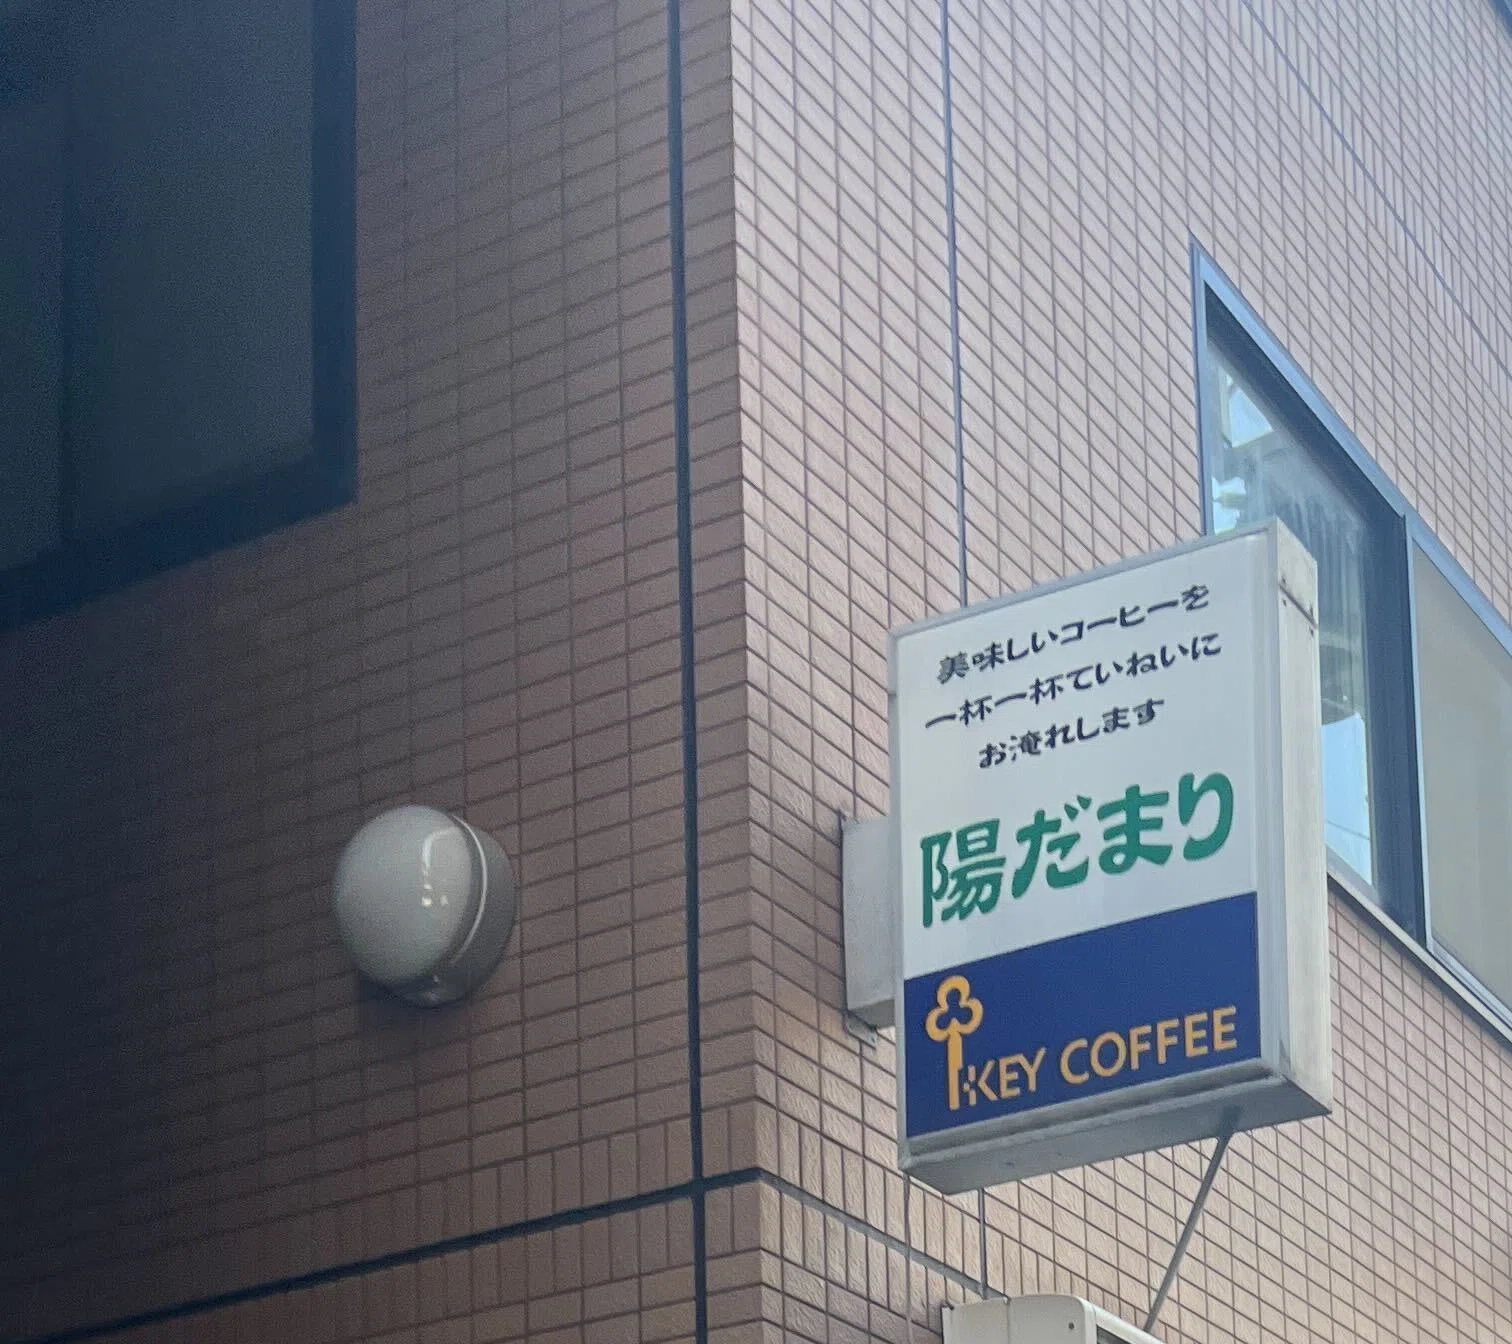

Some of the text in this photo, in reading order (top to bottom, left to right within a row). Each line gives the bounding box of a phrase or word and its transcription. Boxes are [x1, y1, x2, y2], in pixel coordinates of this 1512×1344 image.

[925, 633, 1222, 729] 一杯一杯ていねいに
[937, 584, 1210, 685] 美味しいコーヒーを
[979, 698, 1165, 769] お淹れします
[920, 773, 1235, 928] 陽だまり
[962, 1004, 1238, 1106] KEY COFFEE
